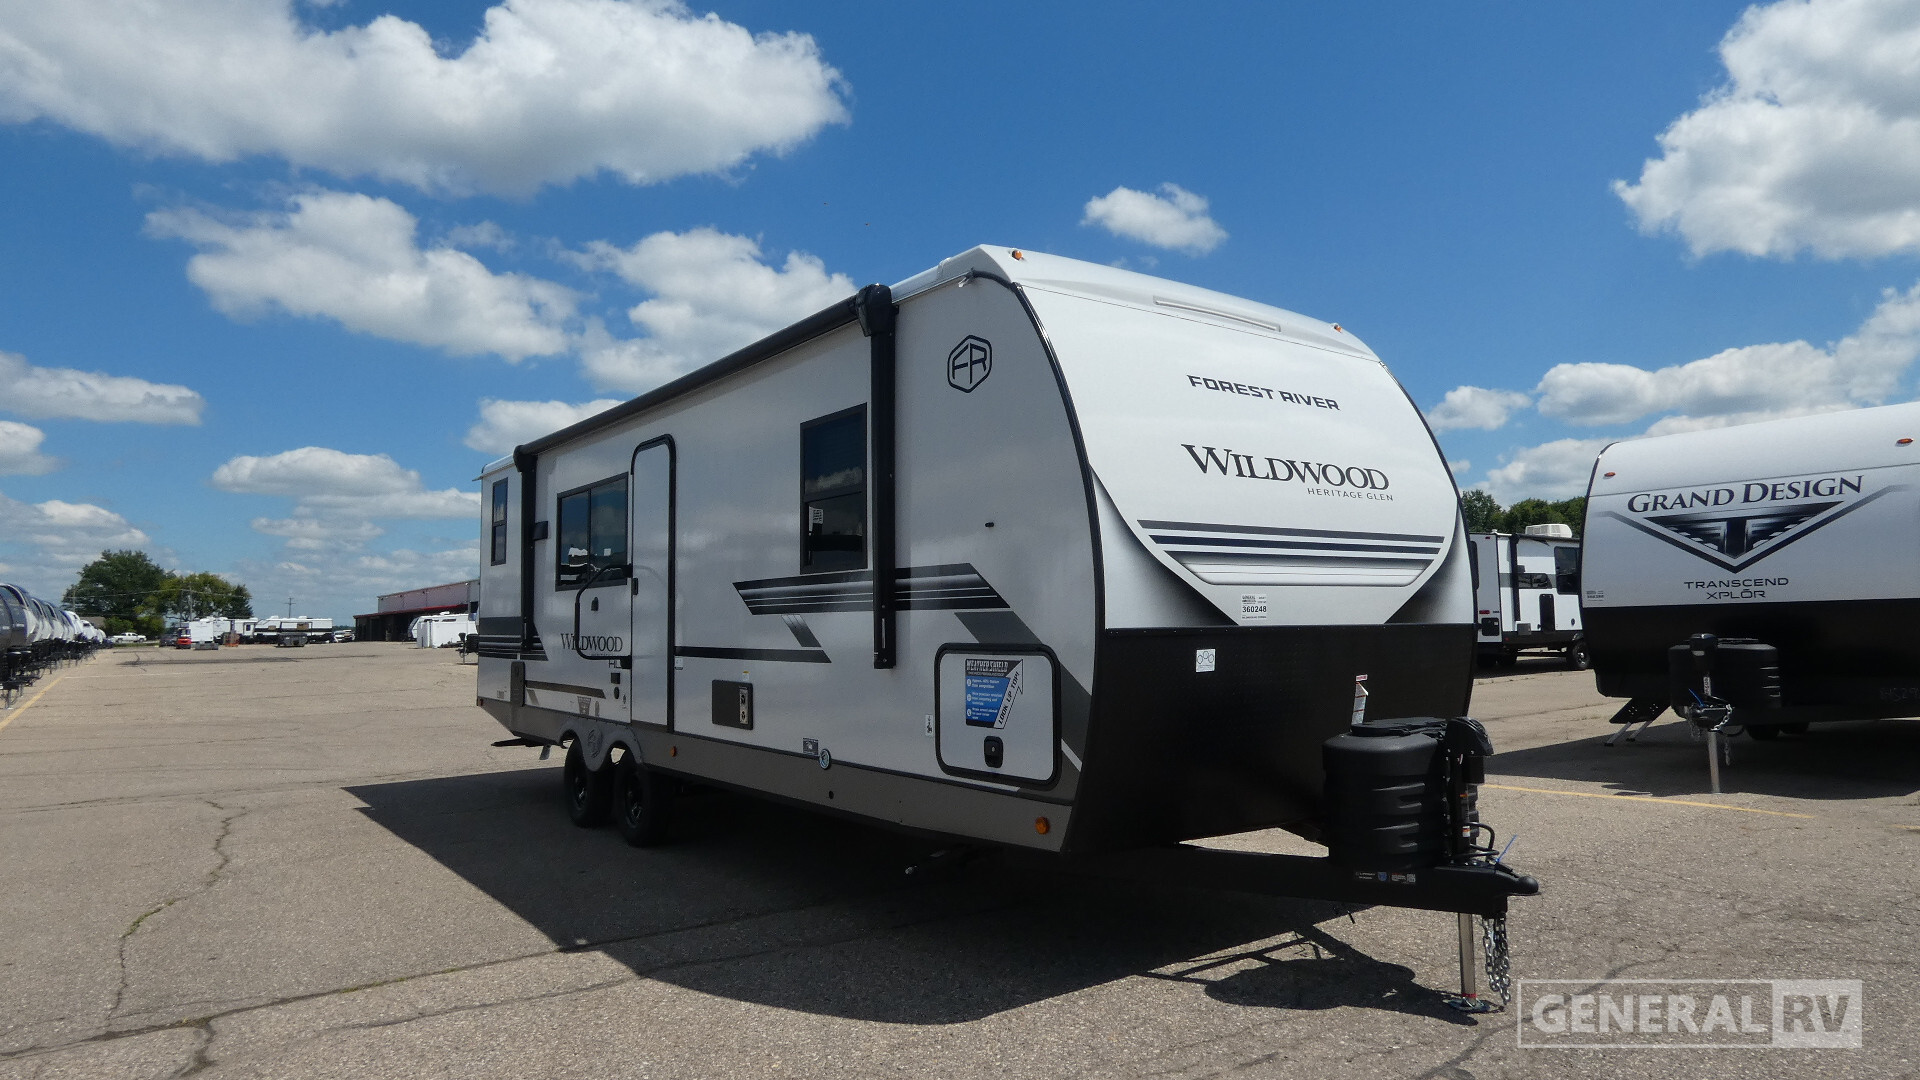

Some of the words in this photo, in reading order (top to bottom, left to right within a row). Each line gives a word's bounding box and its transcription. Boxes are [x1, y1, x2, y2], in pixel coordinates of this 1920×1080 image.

[1186, 374, 1274, 400] FOREST
[1278, 390, 1341, 411] RIVER
[1181, 443, 1390, 491] WILDWOOD
[1307, 487, 1364, 499] HERITAGE
[1366, 491, 1394, 501] GLEN
[1627, 487, 1735, 513] GRAND
[1742, 475, 1865, 504] DESIGN
[1684, 577, 1789, 590] TRANSCEND
[1242, 605, 1267, 613] 360248
[560, 633, 623, 652] WIDWOOD
[998, 705, 1009, 725] LOOK
[1006, 691, 1013, 703] UP
